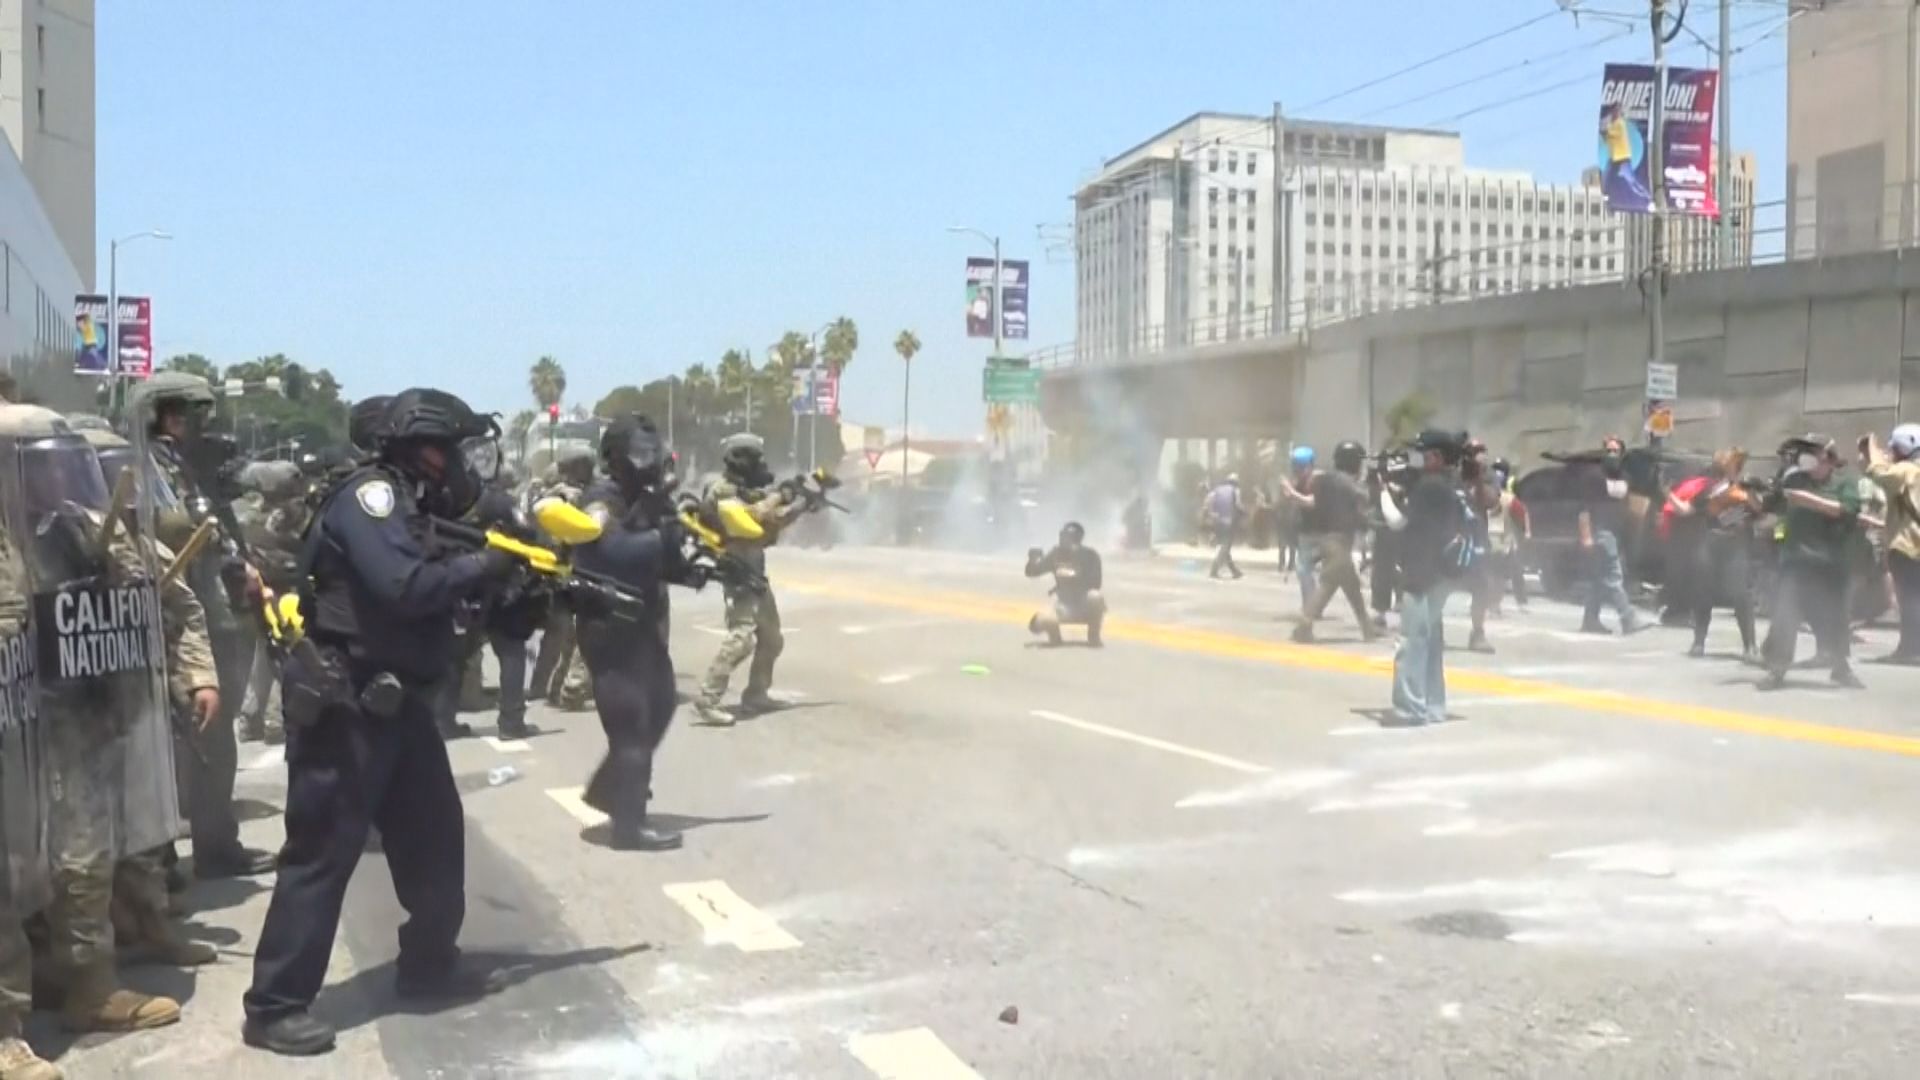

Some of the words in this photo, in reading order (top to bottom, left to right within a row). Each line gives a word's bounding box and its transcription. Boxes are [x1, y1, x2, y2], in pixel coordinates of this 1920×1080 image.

[1600, 80, 1654, 107] GAME
[1664, 83, 1698, 109] ON!
[58, 628, 147, 678] NATIONAL
